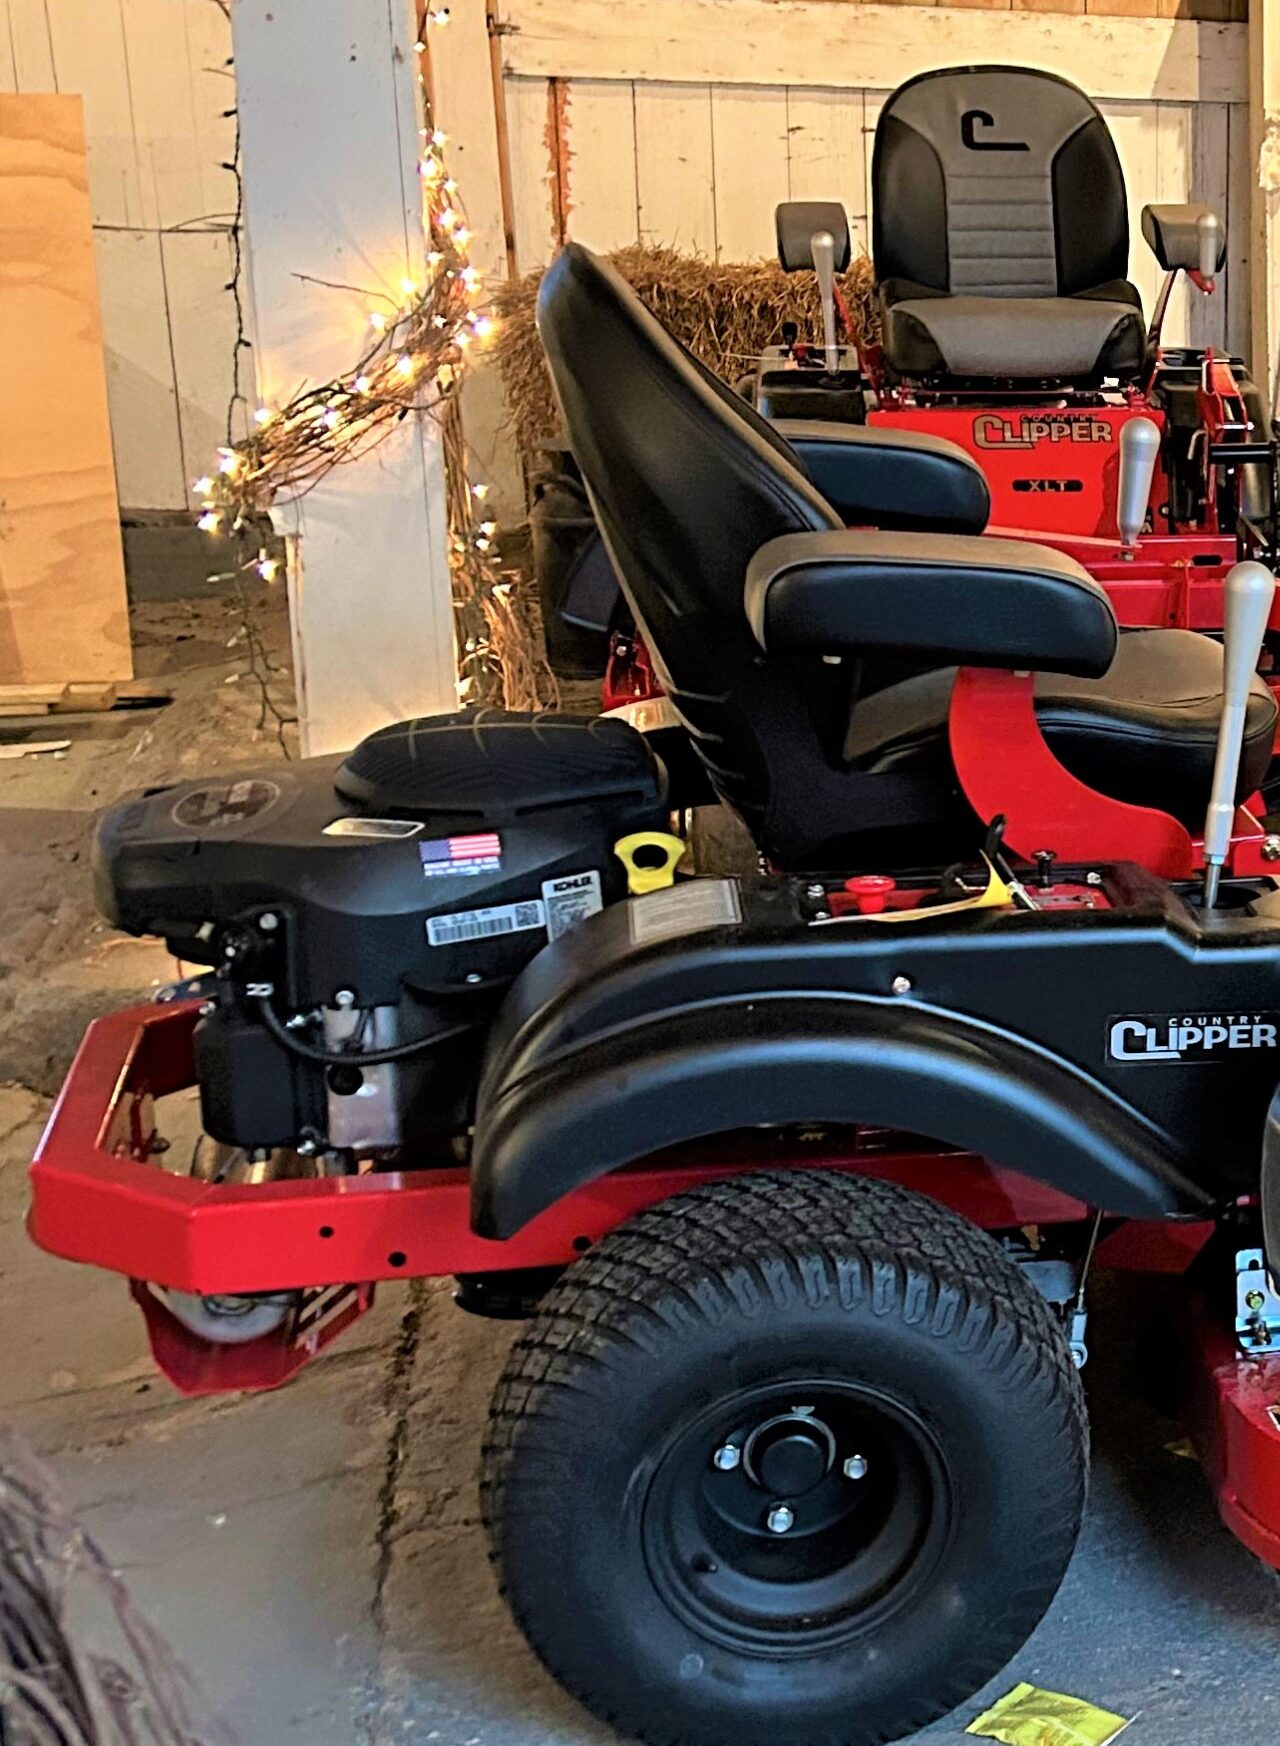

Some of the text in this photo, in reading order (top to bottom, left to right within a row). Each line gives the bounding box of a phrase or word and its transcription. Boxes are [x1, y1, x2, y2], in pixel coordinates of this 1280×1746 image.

[1020, 413, 1100, 422] COUNTRY
[973, 414, 1113, 449] CLIPPER
[1028, 480, 1068, 492] XLT
[553, 876, 594, 893] KOHLER
[1168, 1015, 1262, 1027] COUNTRY
[1110, 1020, 1277, 1061] CLIPPER
